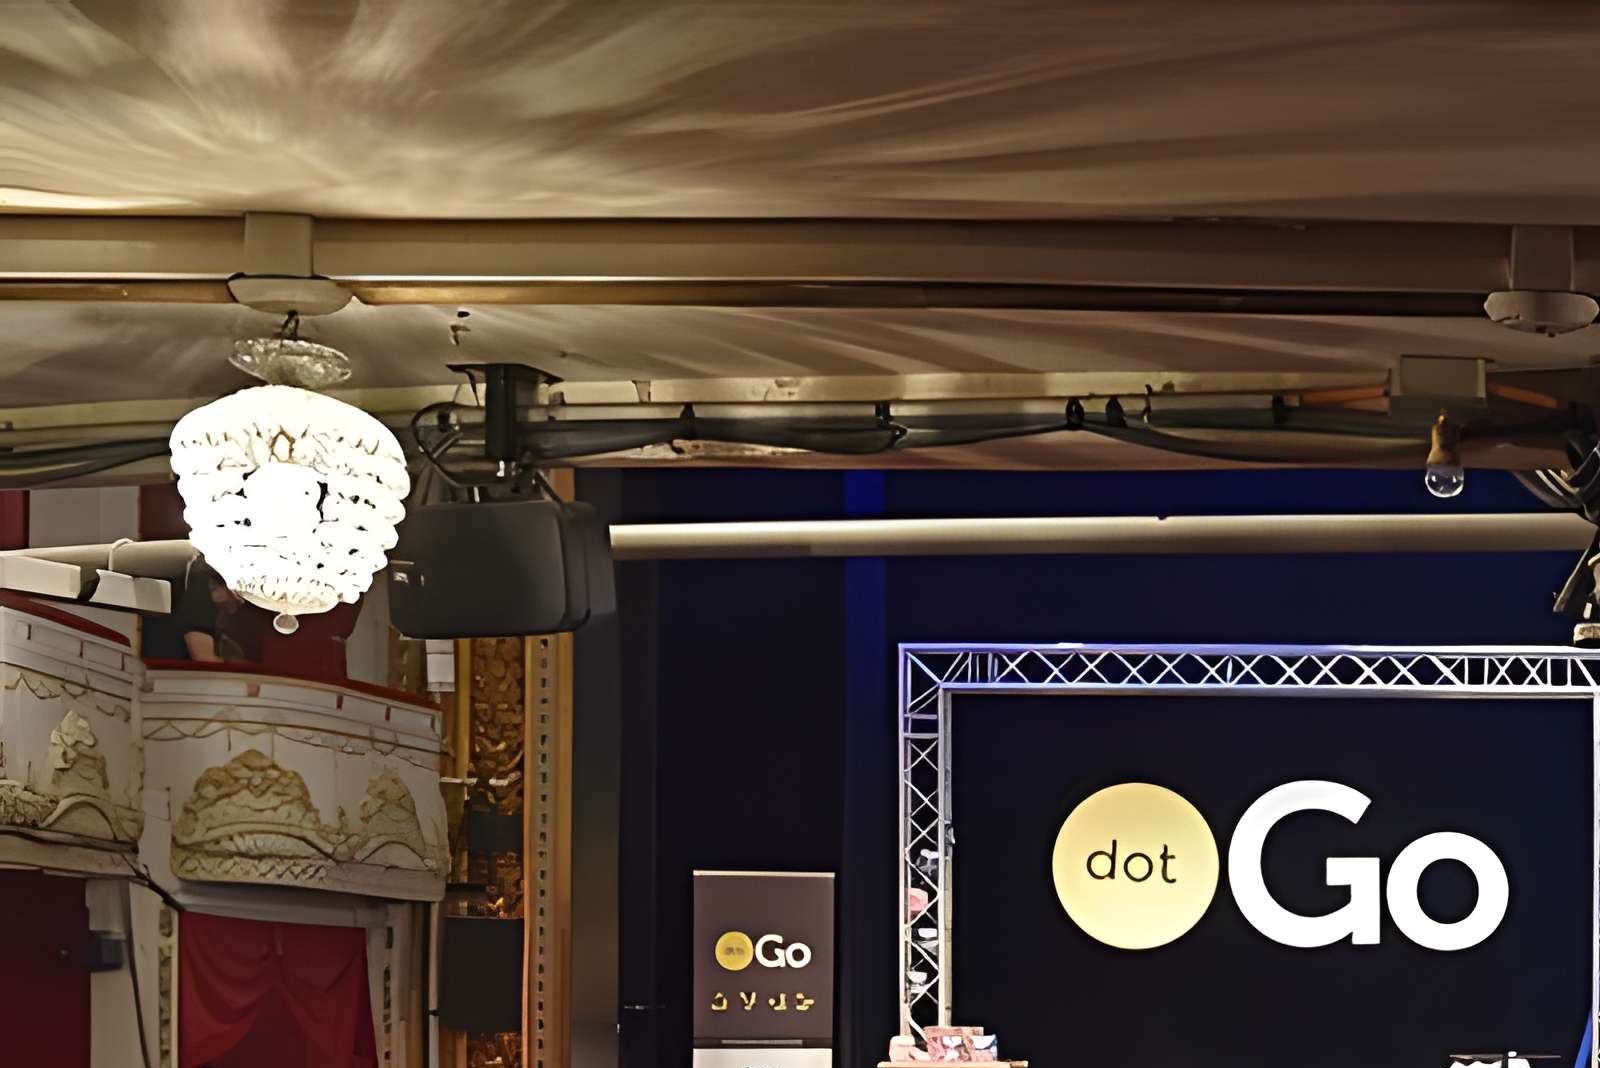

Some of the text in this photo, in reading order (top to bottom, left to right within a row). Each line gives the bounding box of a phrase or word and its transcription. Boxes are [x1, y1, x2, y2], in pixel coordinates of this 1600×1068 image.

[1086, 779, 1510, 952] dot Go
[755, 933, 812, 969] Go
